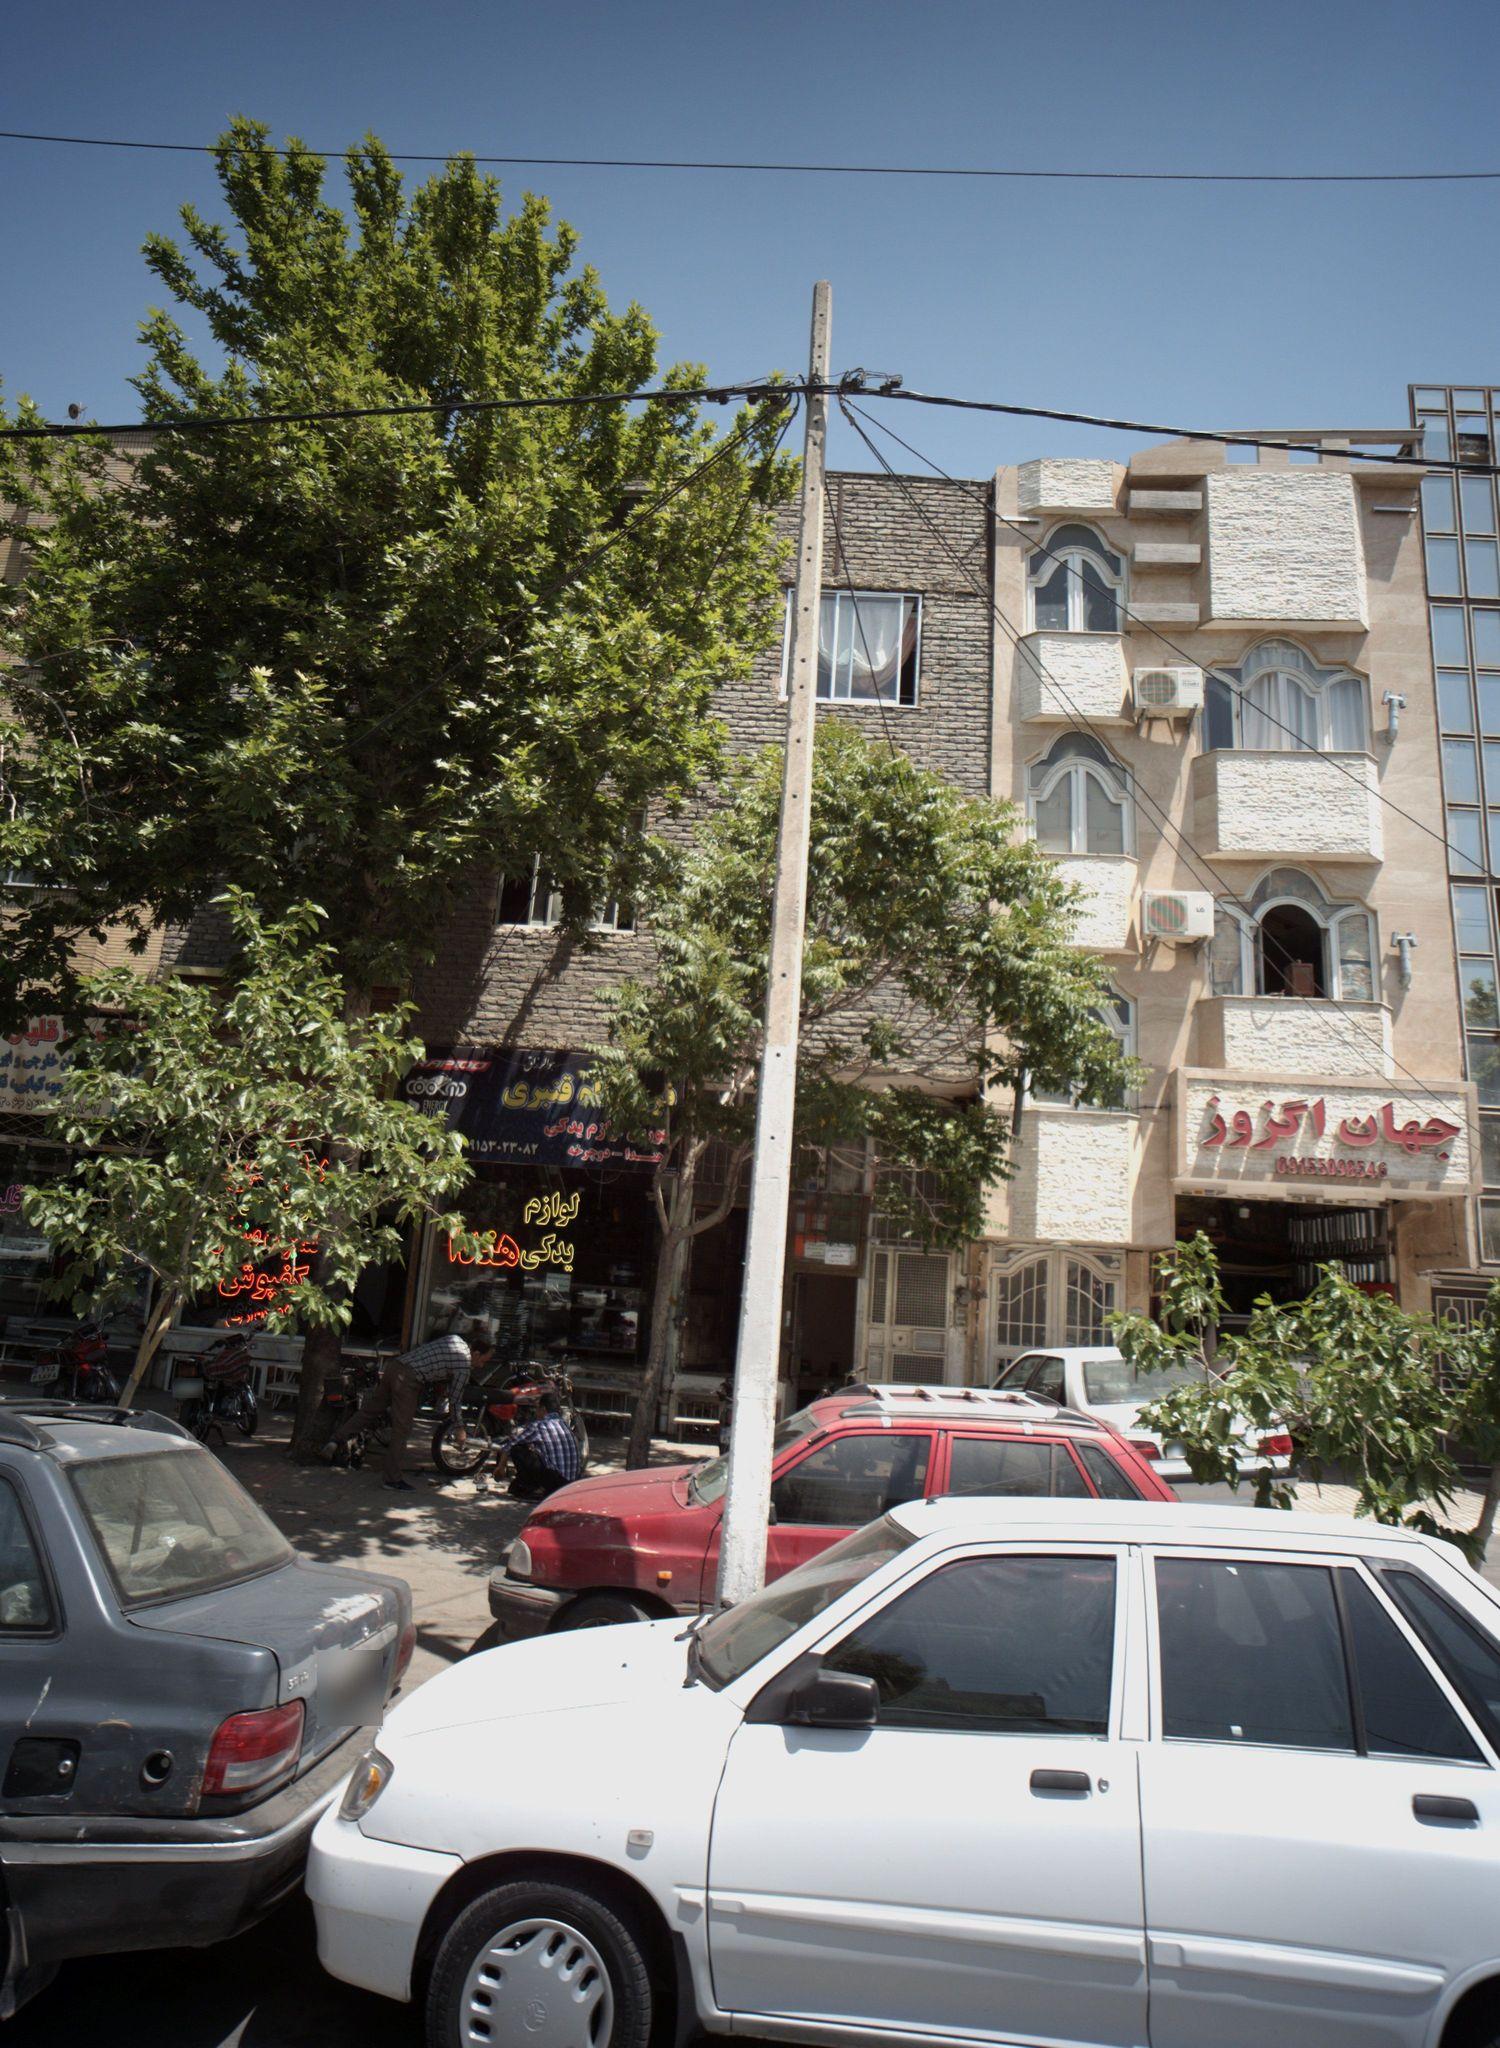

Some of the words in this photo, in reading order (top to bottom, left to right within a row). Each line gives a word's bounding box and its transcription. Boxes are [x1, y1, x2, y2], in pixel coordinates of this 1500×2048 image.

[502, 1073, 575, 1111] قنبری
[544, 1116, 585, 1138] یدکی
[1201, 1095, 1326, 1150] اگزوز
[1337, 1101, 1462, 1161] جهان
[524, 1190, 581, 1227] لوازم
[520, 1233, 575, 1272] یدکی
